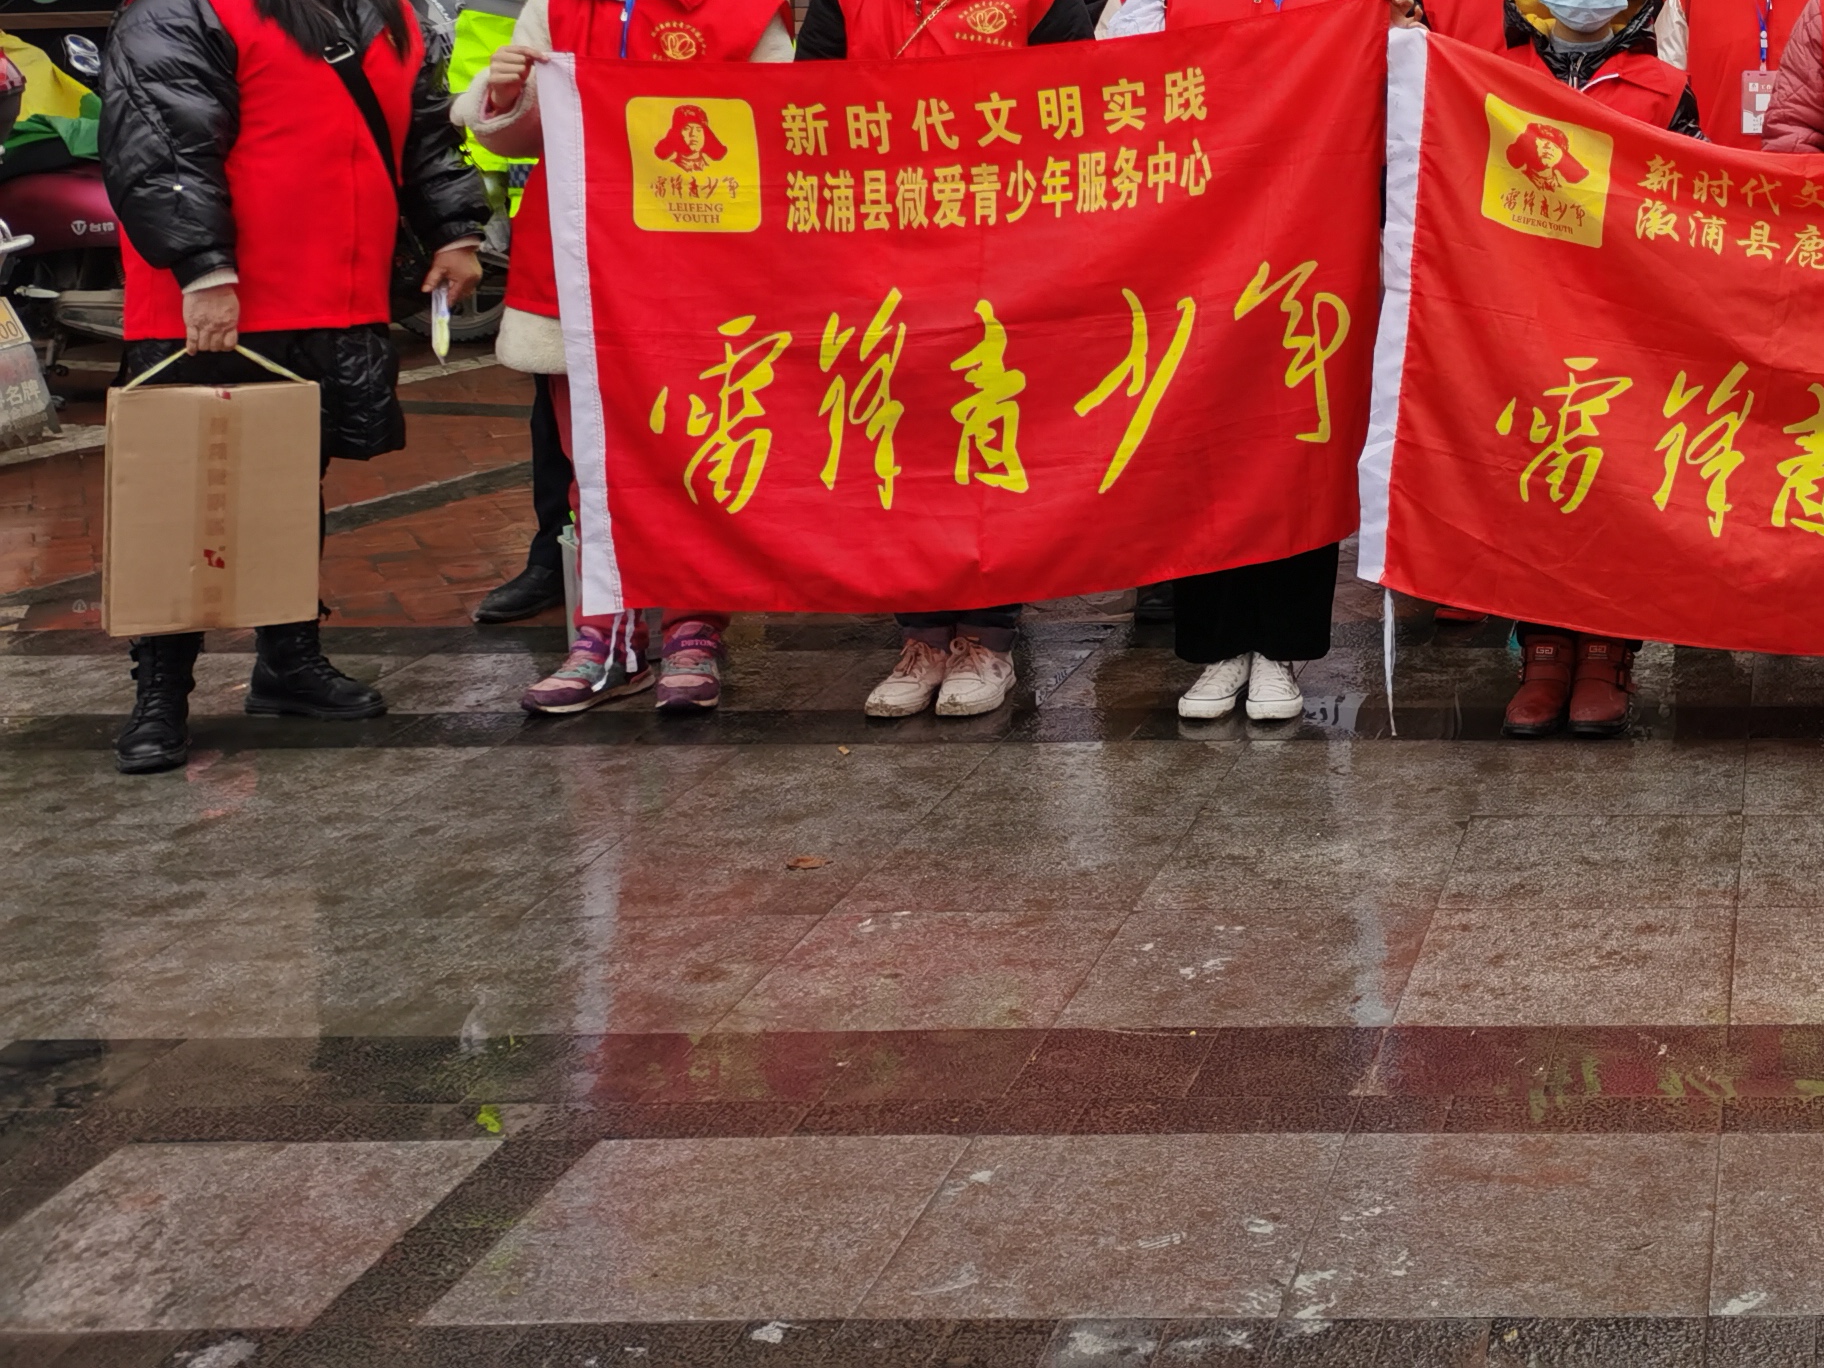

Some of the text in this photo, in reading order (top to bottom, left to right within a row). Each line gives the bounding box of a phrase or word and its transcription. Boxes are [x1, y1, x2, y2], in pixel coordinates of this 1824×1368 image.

[781, 67, 1209, 158] 新时代文明实践
[668, 202, 724, 213] LEIFENG
[785, 138, 1212, 234] 溆浦县微爱青少年服务中心
[672, 213, 720, 224] YOUTH
[1511, 214, 1574, 235] LEIFENG YOUTH
[651, 260, 1352, 514] 雷锋青少年
